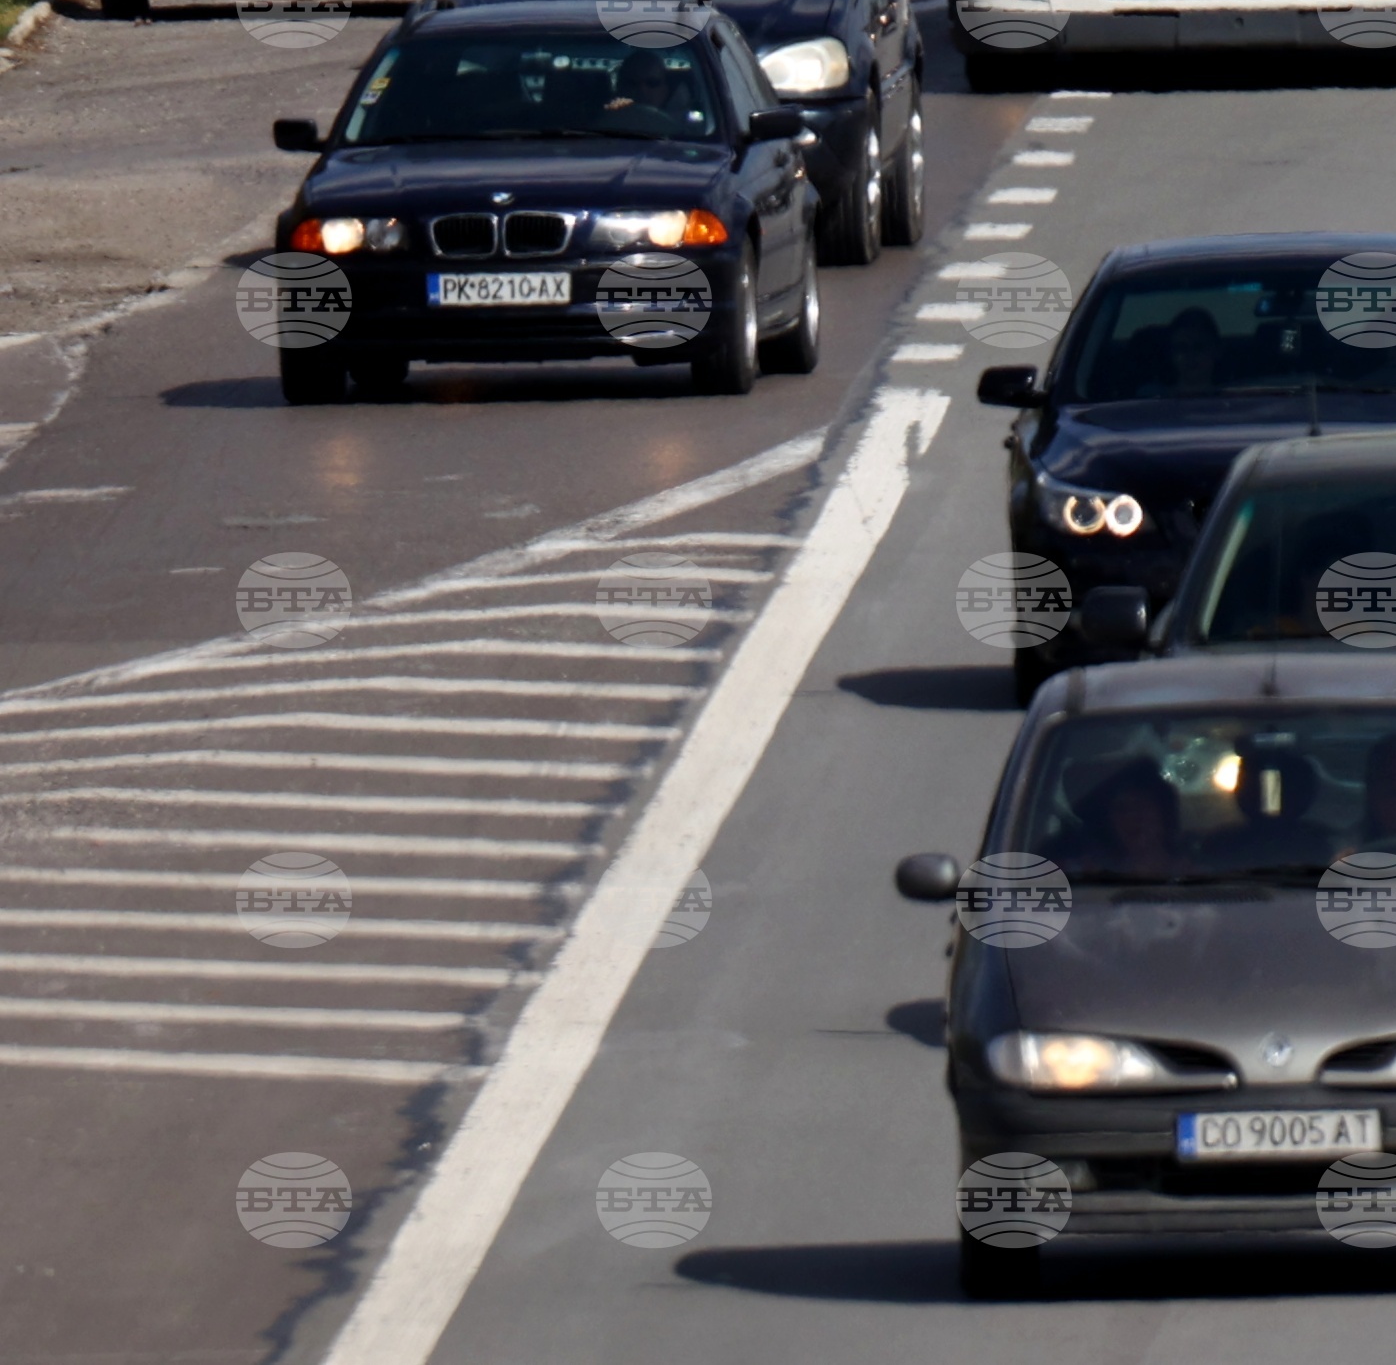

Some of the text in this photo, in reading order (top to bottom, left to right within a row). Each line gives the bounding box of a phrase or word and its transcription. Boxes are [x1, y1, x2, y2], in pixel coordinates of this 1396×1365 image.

[442, 278, 471, 301] PK
[538, 276, 565, 298] AX
[1249, 1115, 1326, 1146] 9005
[1334, 1114, 1373, 1144] AT
